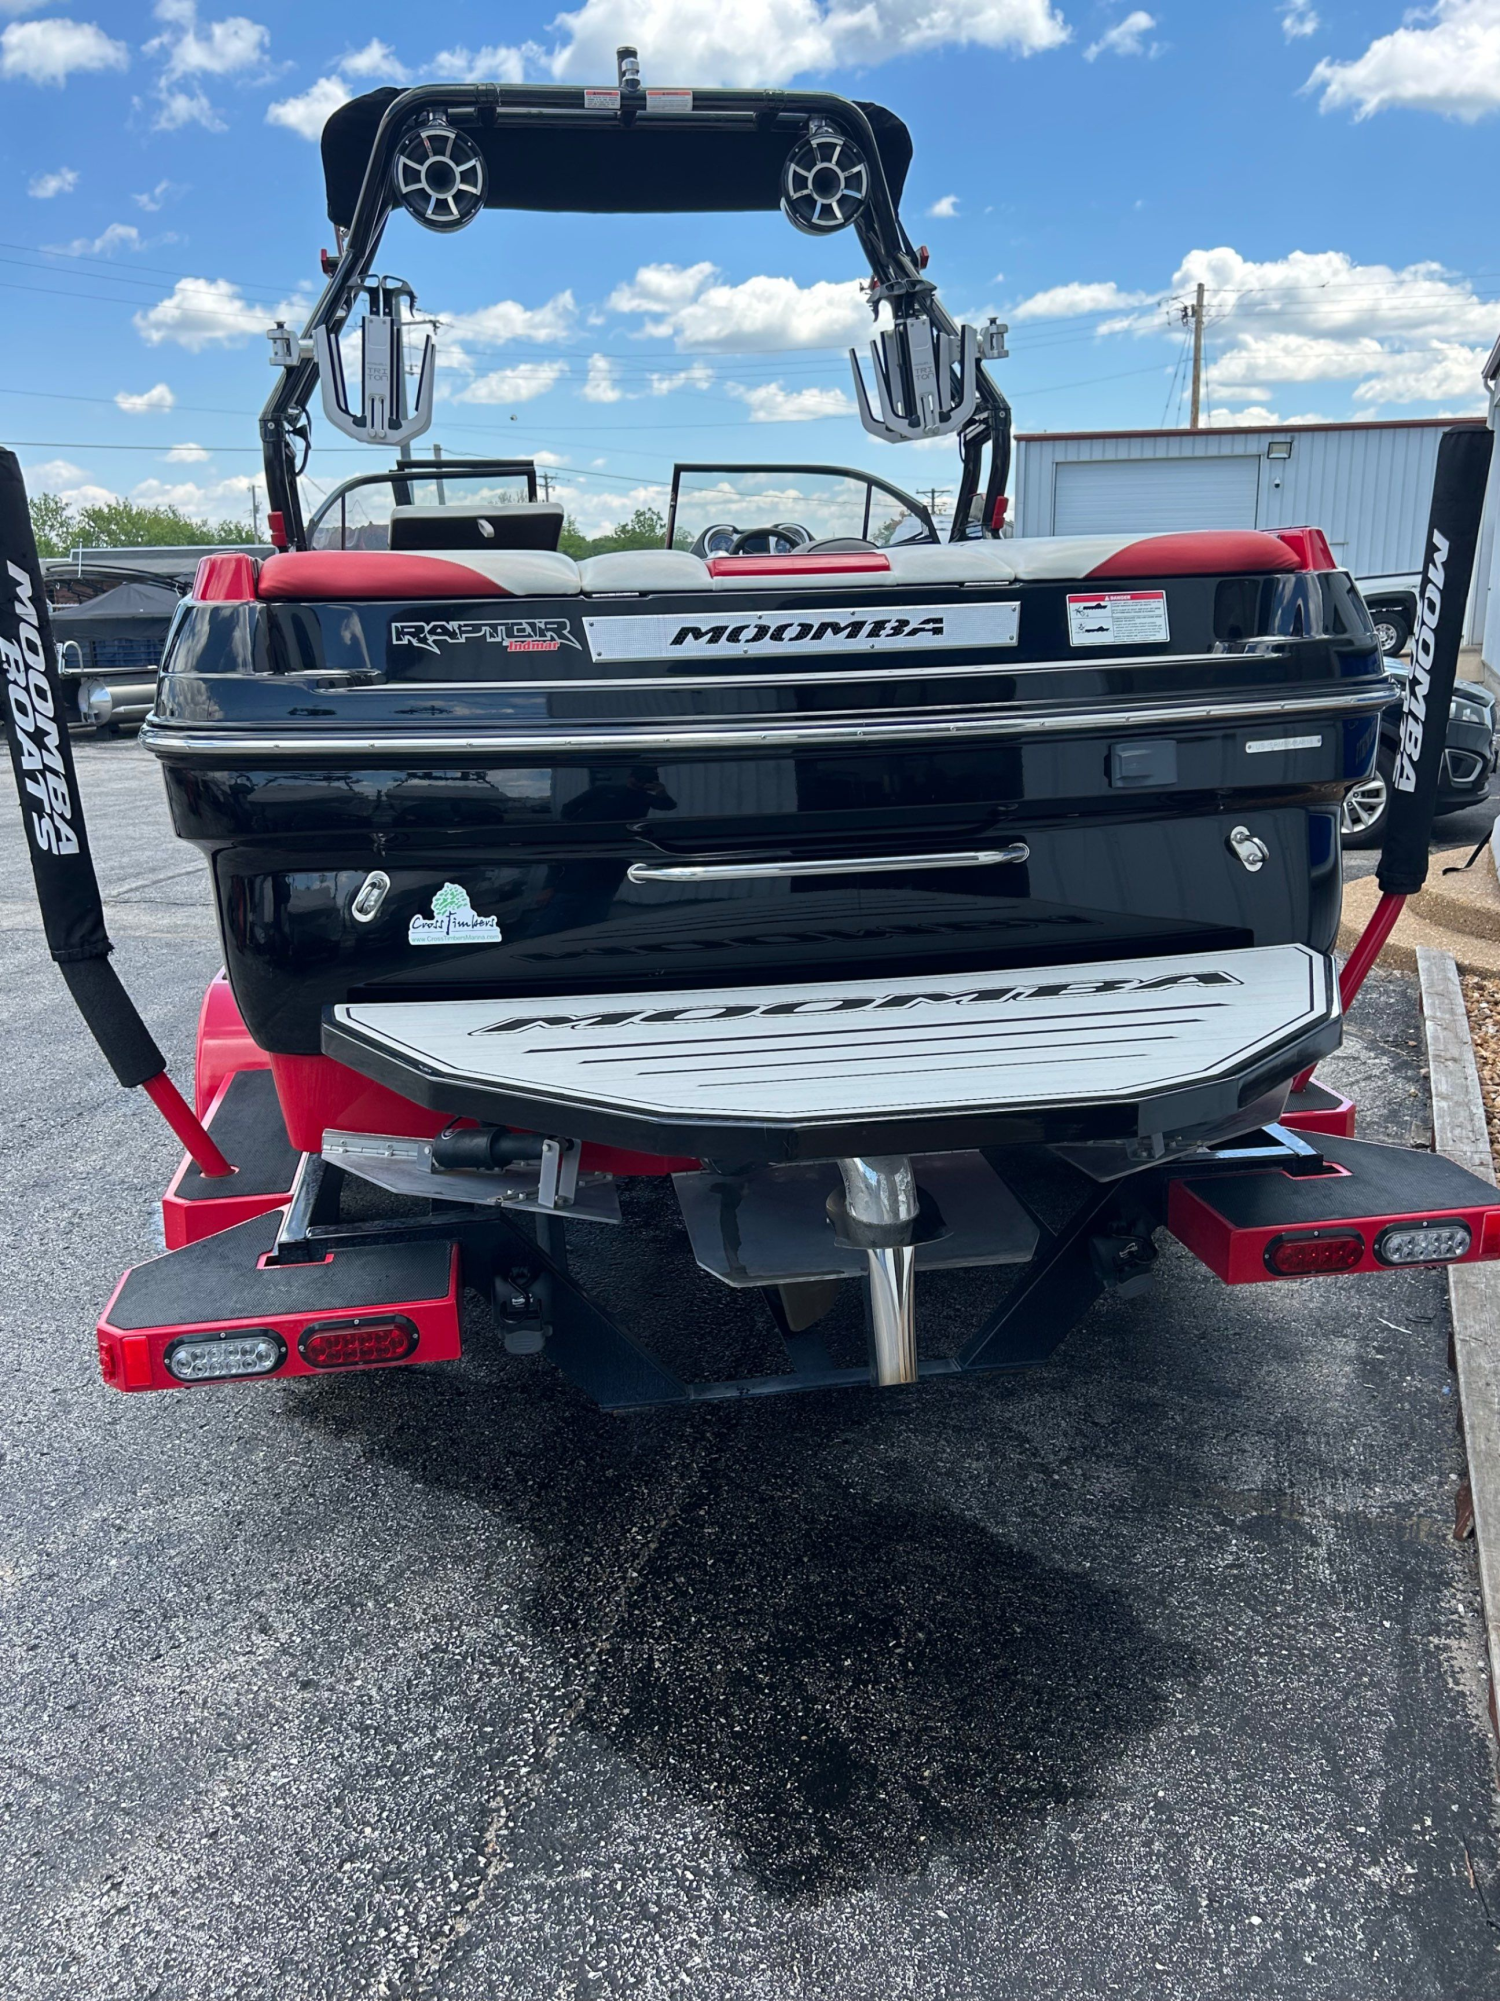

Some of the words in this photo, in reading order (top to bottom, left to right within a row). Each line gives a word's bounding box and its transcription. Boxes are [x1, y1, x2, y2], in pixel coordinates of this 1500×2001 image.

[391, 618, 583, 655] RAPTOR
[507, 640, 560, 652] Indmar
[669, 617, 944, 646] MOOMBA
[1395, 528, 1450, 793] MOOMBA
[6, 559, 80, 855] MOOMBA
[0, 636, 60, 856] BOATS
[411, 916, 444, 930] Cross
[467, 970, 1244, 1036] MOOMBA
